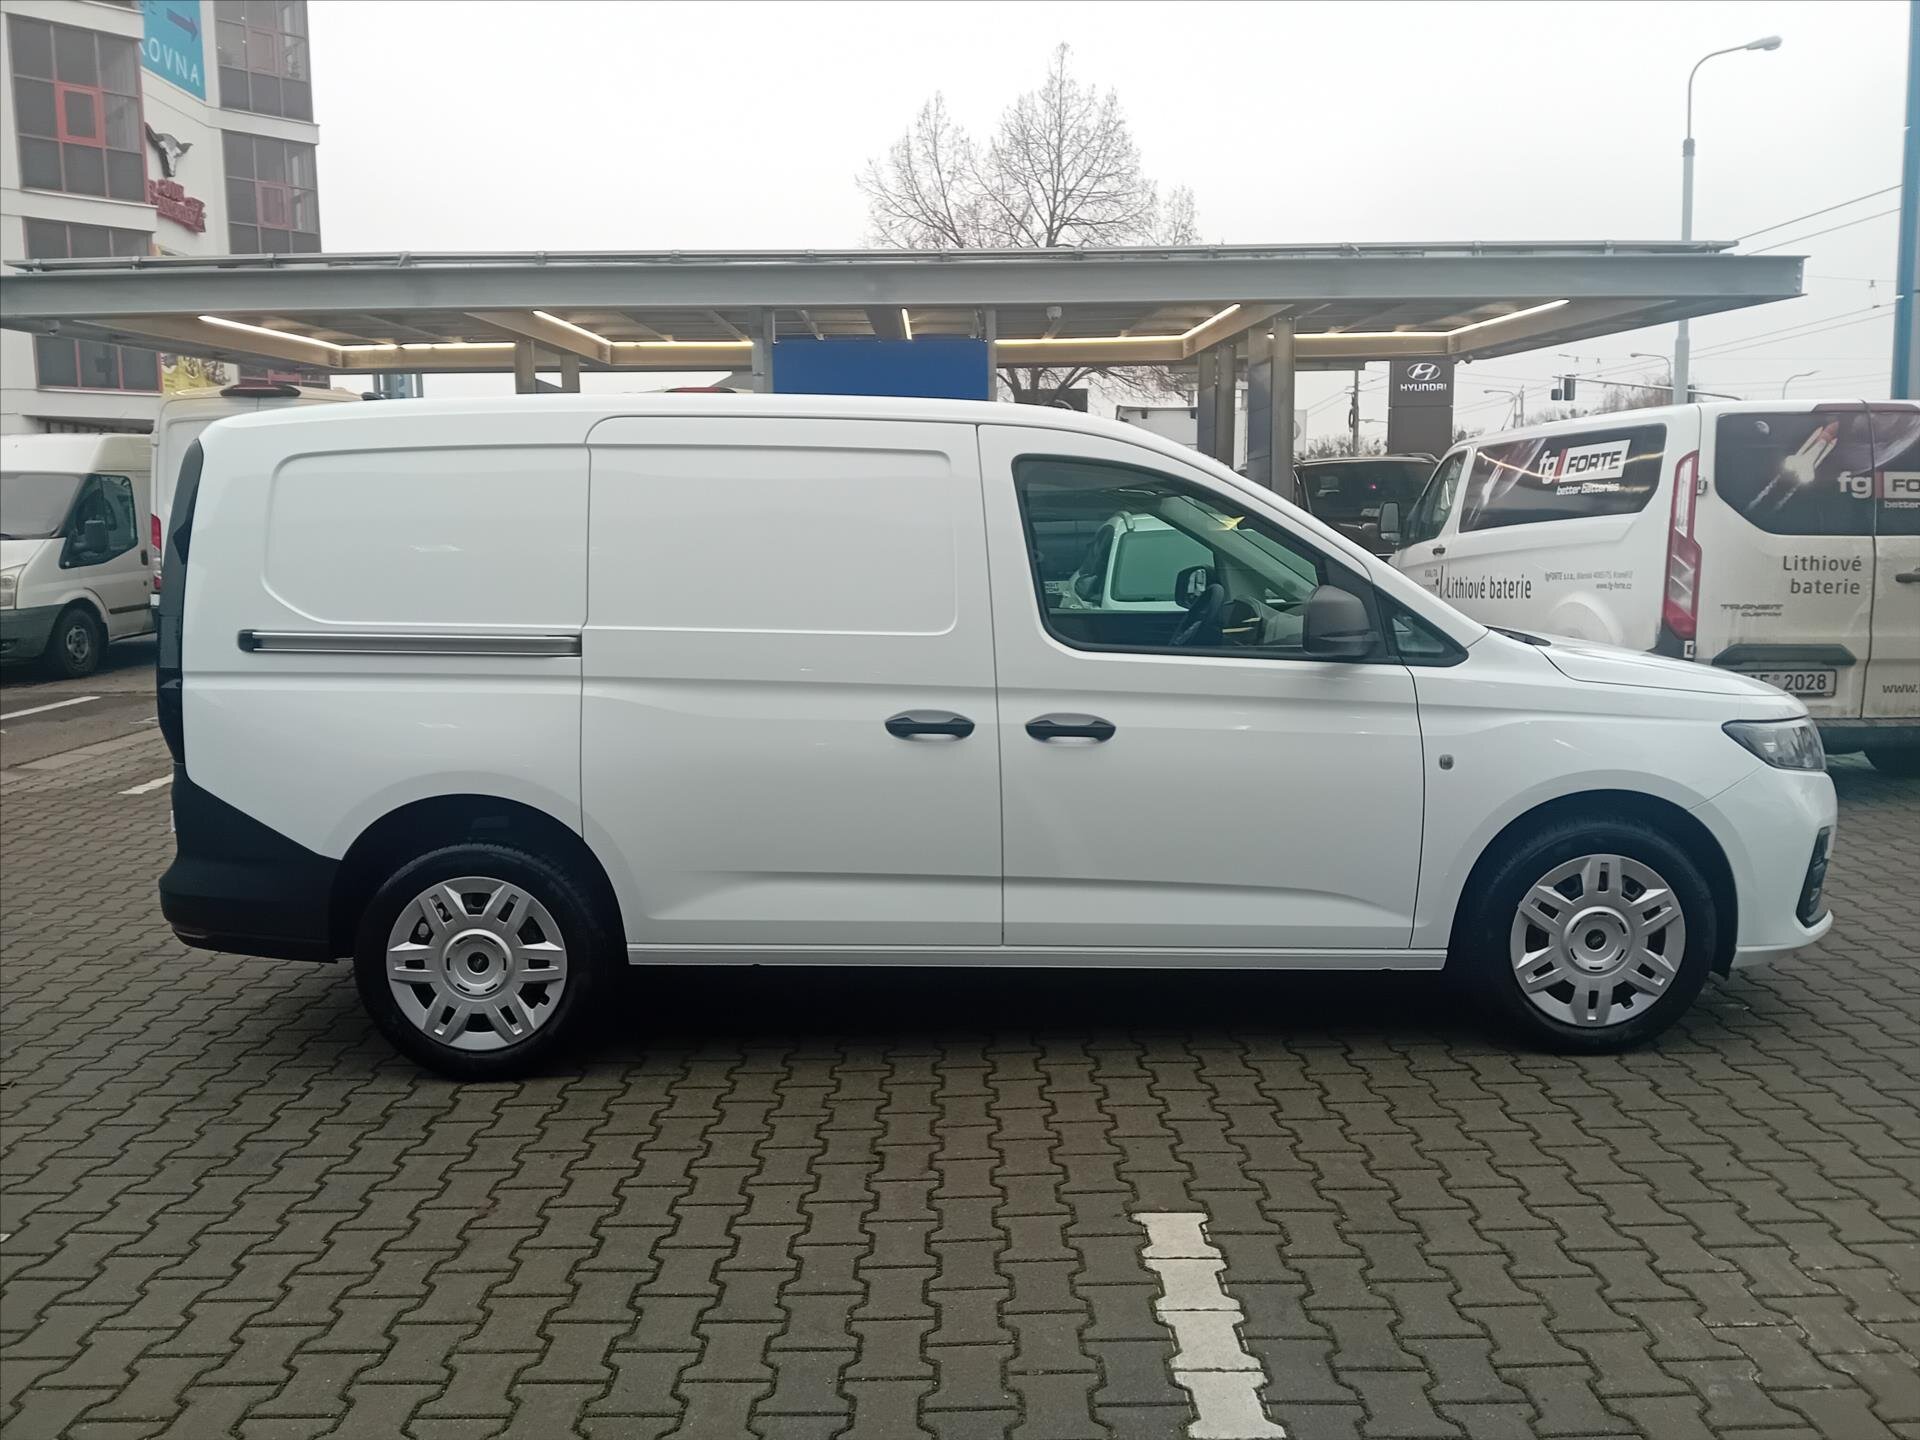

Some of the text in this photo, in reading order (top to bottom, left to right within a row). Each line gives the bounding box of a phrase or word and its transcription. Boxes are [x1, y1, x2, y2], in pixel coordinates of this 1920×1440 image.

[138, 36, 200, 87] OVNA
[1400, 383, 1446, 391] HYUNDAI
[1538, 450, 1622, 484] fg FORTE
[1556, 484, 1581, 495] better
[1837, 471, 1873, 499] fg
[1783, 555, 1862, 571] Lithiové
[1446, 573, 1532, 599] Lithiové baterie
[1790, 578, 1861, 594] baterie
[1783, 673, 1827, 691] 2028
